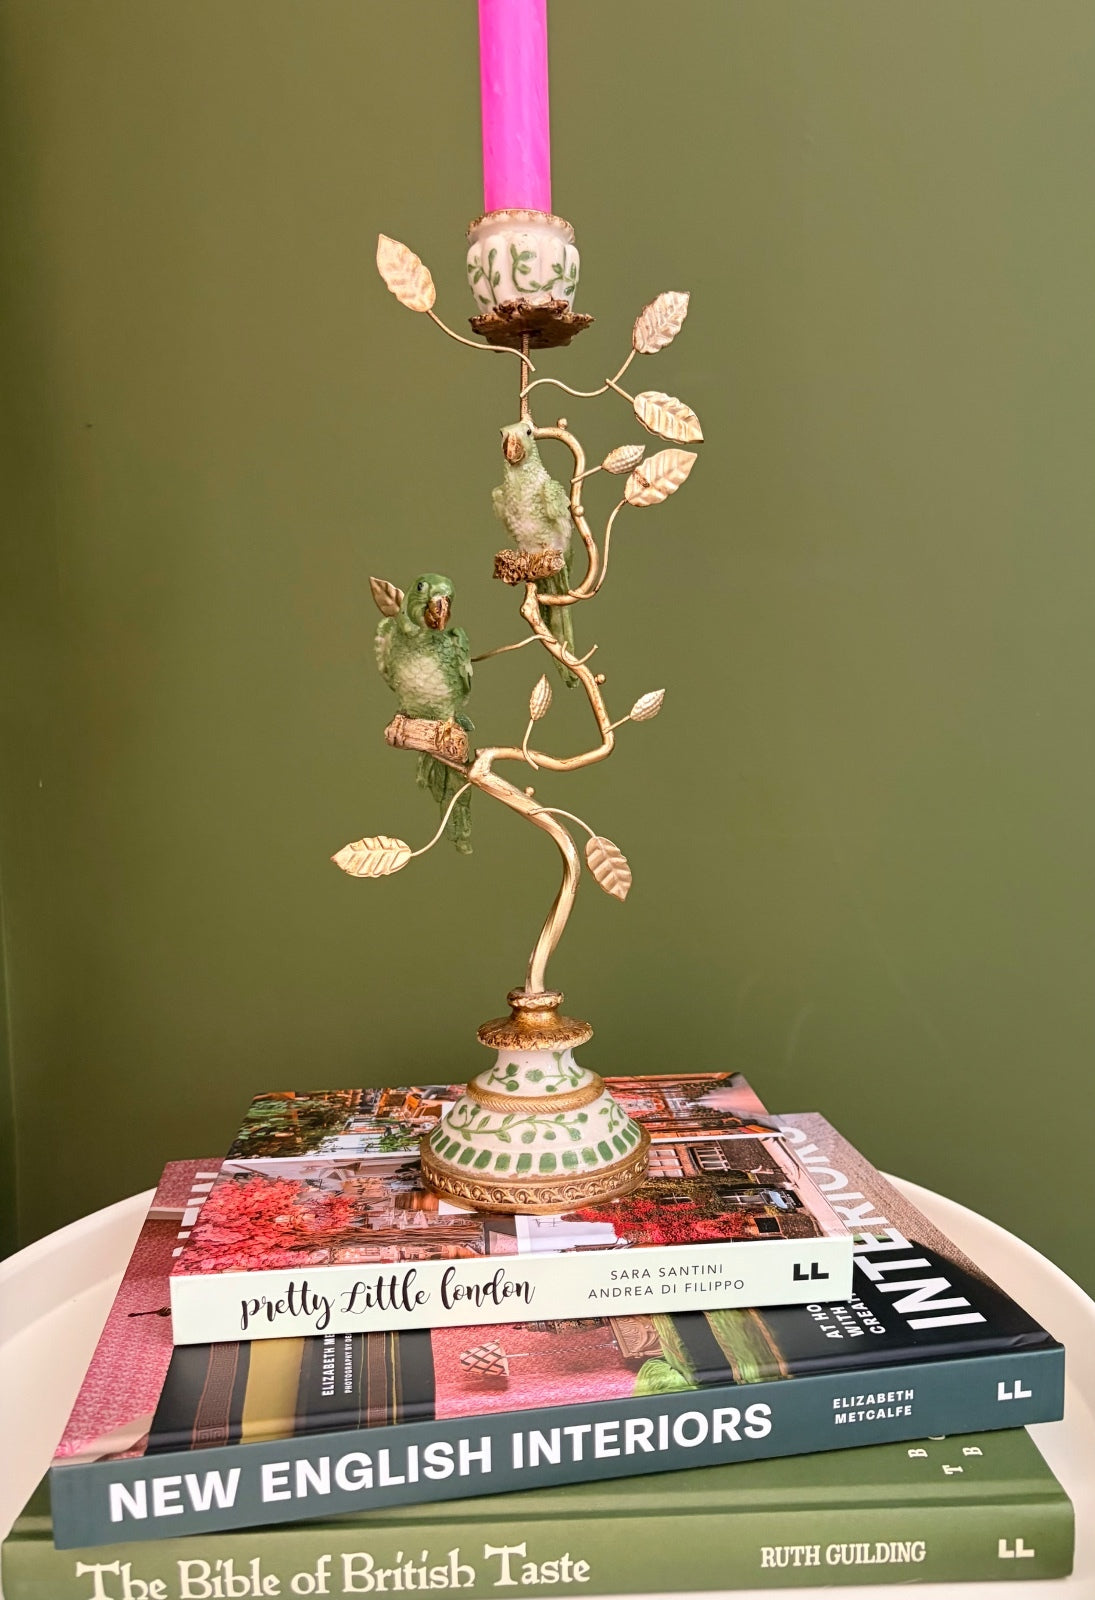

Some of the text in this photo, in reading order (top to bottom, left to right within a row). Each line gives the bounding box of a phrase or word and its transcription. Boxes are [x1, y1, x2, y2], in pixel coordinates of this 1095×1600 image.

[610, 1263, 724, 1281] SARA SANTINI
[792, 1262, 830, 1282] LL
[240, 1266, 536, 1331] pretty Little london
[588, 1279, 745, 1300] ANDREA DI FILIPPO
[819, 1324, 844, 1339] AT
[829, 1306, 865, 1338] WITH
[321, 1347, 335, 1396] ELIZABETH
[344, 1351, 353, 1394] PHOTOGRAPHY
[833, 1389, 915, 1409] ELIZABETH
[996, 1379, 1033, 1401] LL
[834, 1404, 913, 1425] METCALFE
[108, 1403, 773, 1523] NEW ENGLISH INTERIORS
[760, 1540, 927, 1568] RUTH GUILDING
[997, 1538, 1035, 1559] LL
[75, 1541, 591, 1600] The Bible of British Taste
